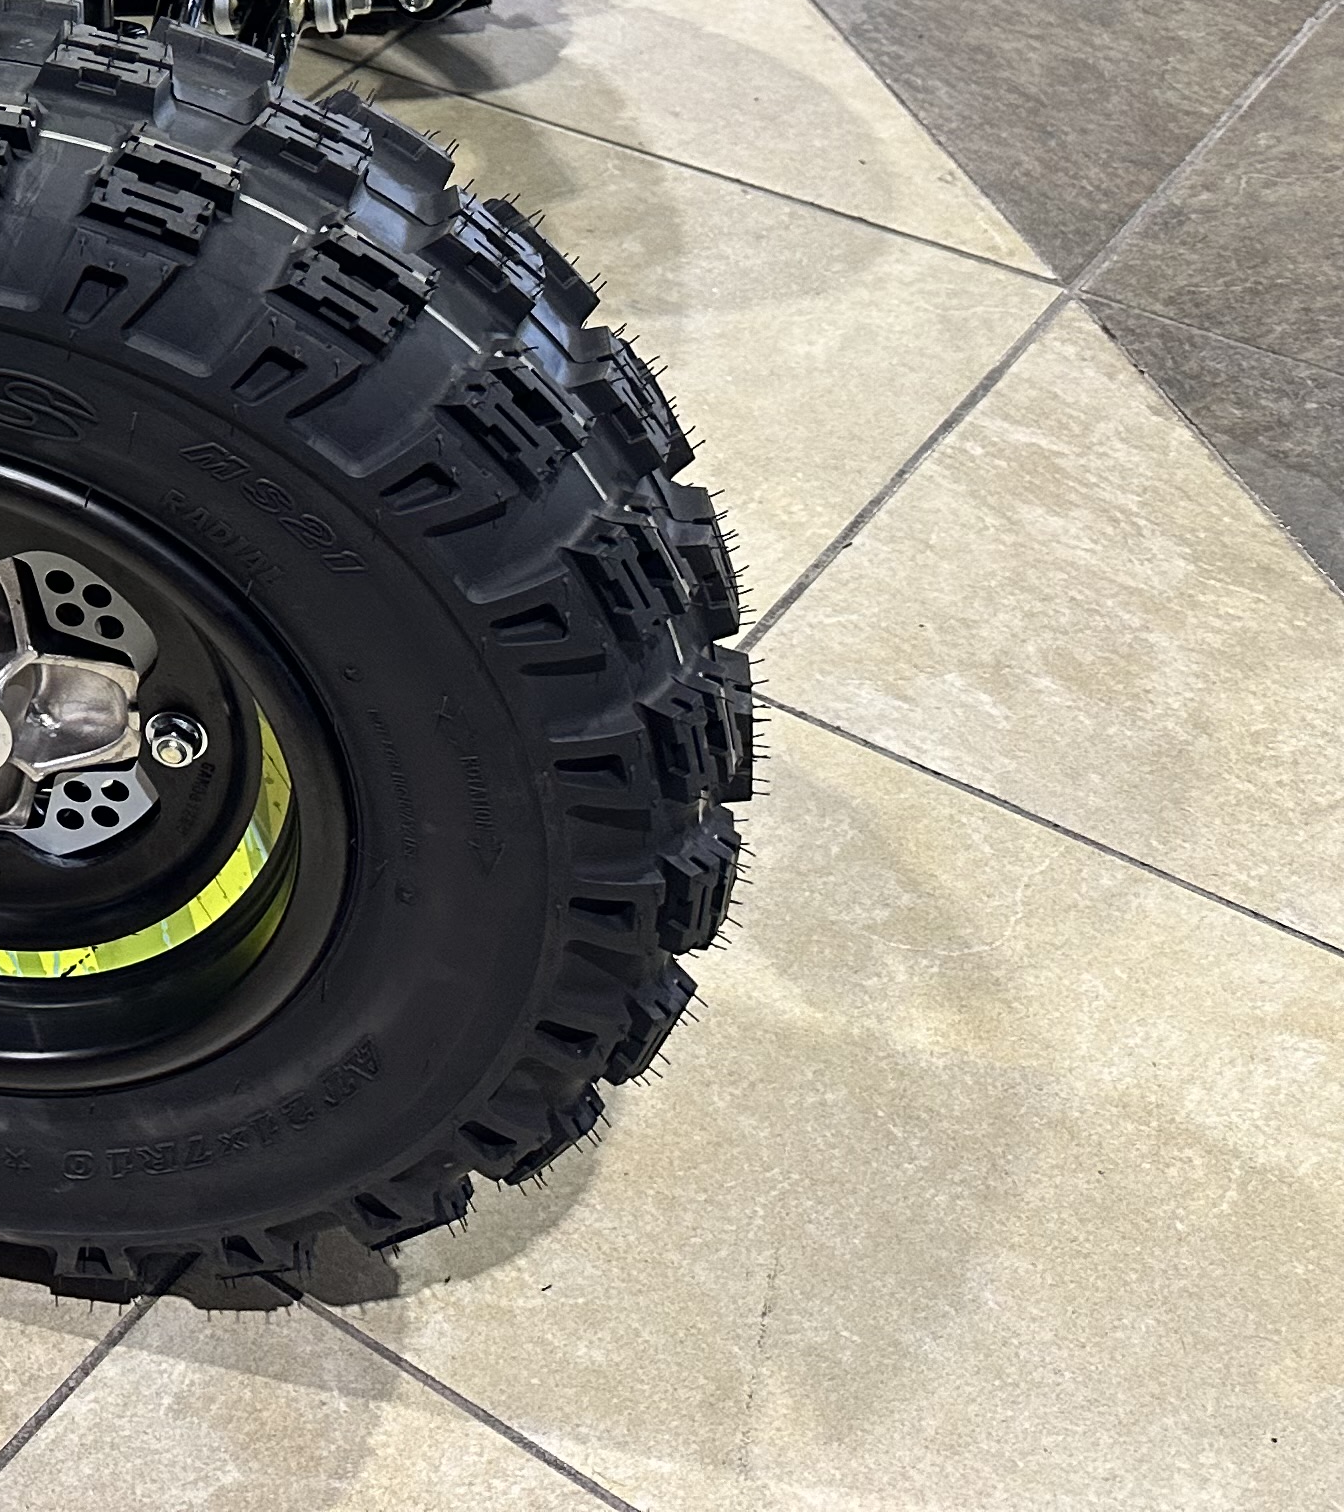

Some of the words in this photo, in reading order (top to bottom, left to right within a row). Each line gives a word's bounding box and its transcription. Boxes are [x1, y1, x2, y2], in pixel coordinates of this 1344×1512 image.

[160, 487, 286, 587] RADIAL
[178, 440, 369, 574] MS21
[457, 754, 496, 831] ROTATION
[321, 1034, 382, 1110] AT
